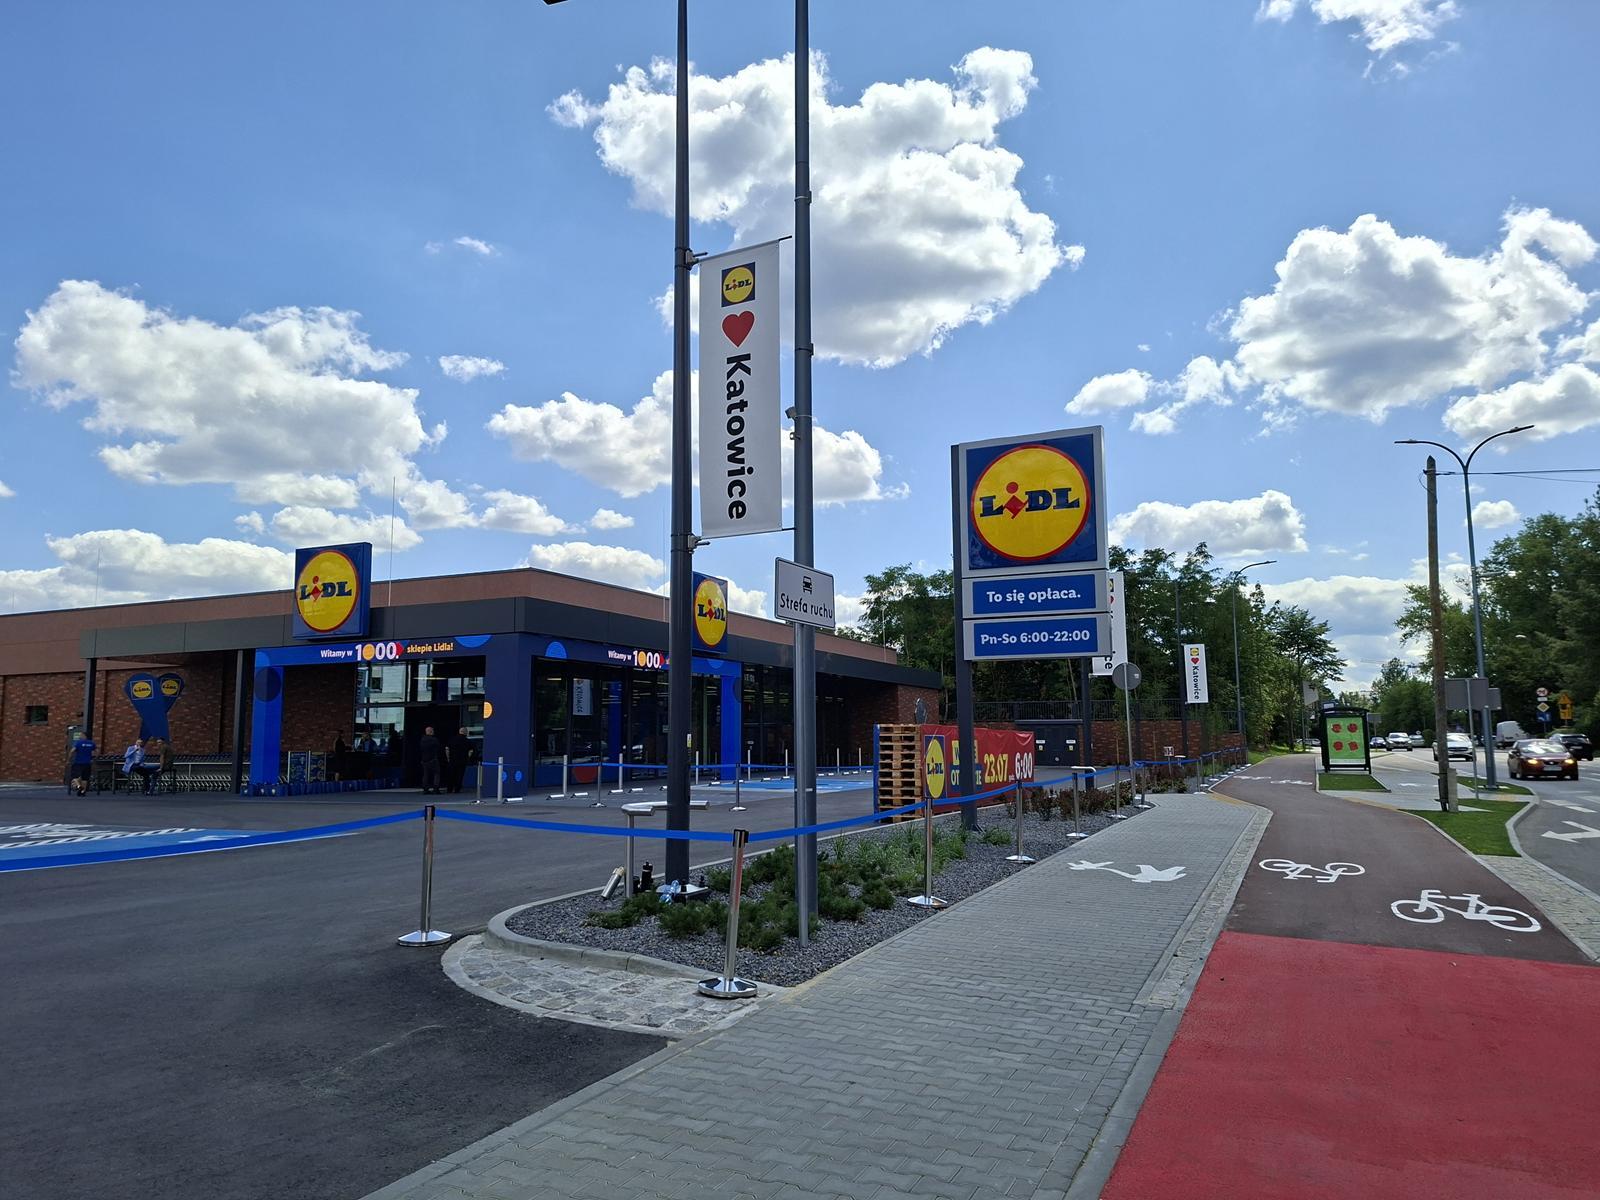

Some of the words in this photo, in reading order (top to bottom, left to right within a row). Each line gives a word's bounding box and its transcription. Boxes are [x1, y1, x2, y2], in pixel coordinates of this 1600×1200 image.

[726, 353, 754, 520] Katowice
[780, 593, 807, 613] Strefa
[810, 604, 833, 619] ruchu
[986, 591, 1002, 603] To
[1006, 589, 1025, 604] się
[1028, 588, 1081, 603] opłaca.
[320, 649, 346, 659] Witamy
[346, 649, 353, 657] w
[407, 644, 432, 654] sklepie
[433, 642, 454, 652] Lidla!
[980, 633, 1017, 645] Pn-So
[1020, 630, 1090, 643] 6:00-22:00
[1192, 665, 1201, 700] Katowice
[983, 753, 1008, 784] 23.07
[1015, 752, 1033, 780] 6:00
